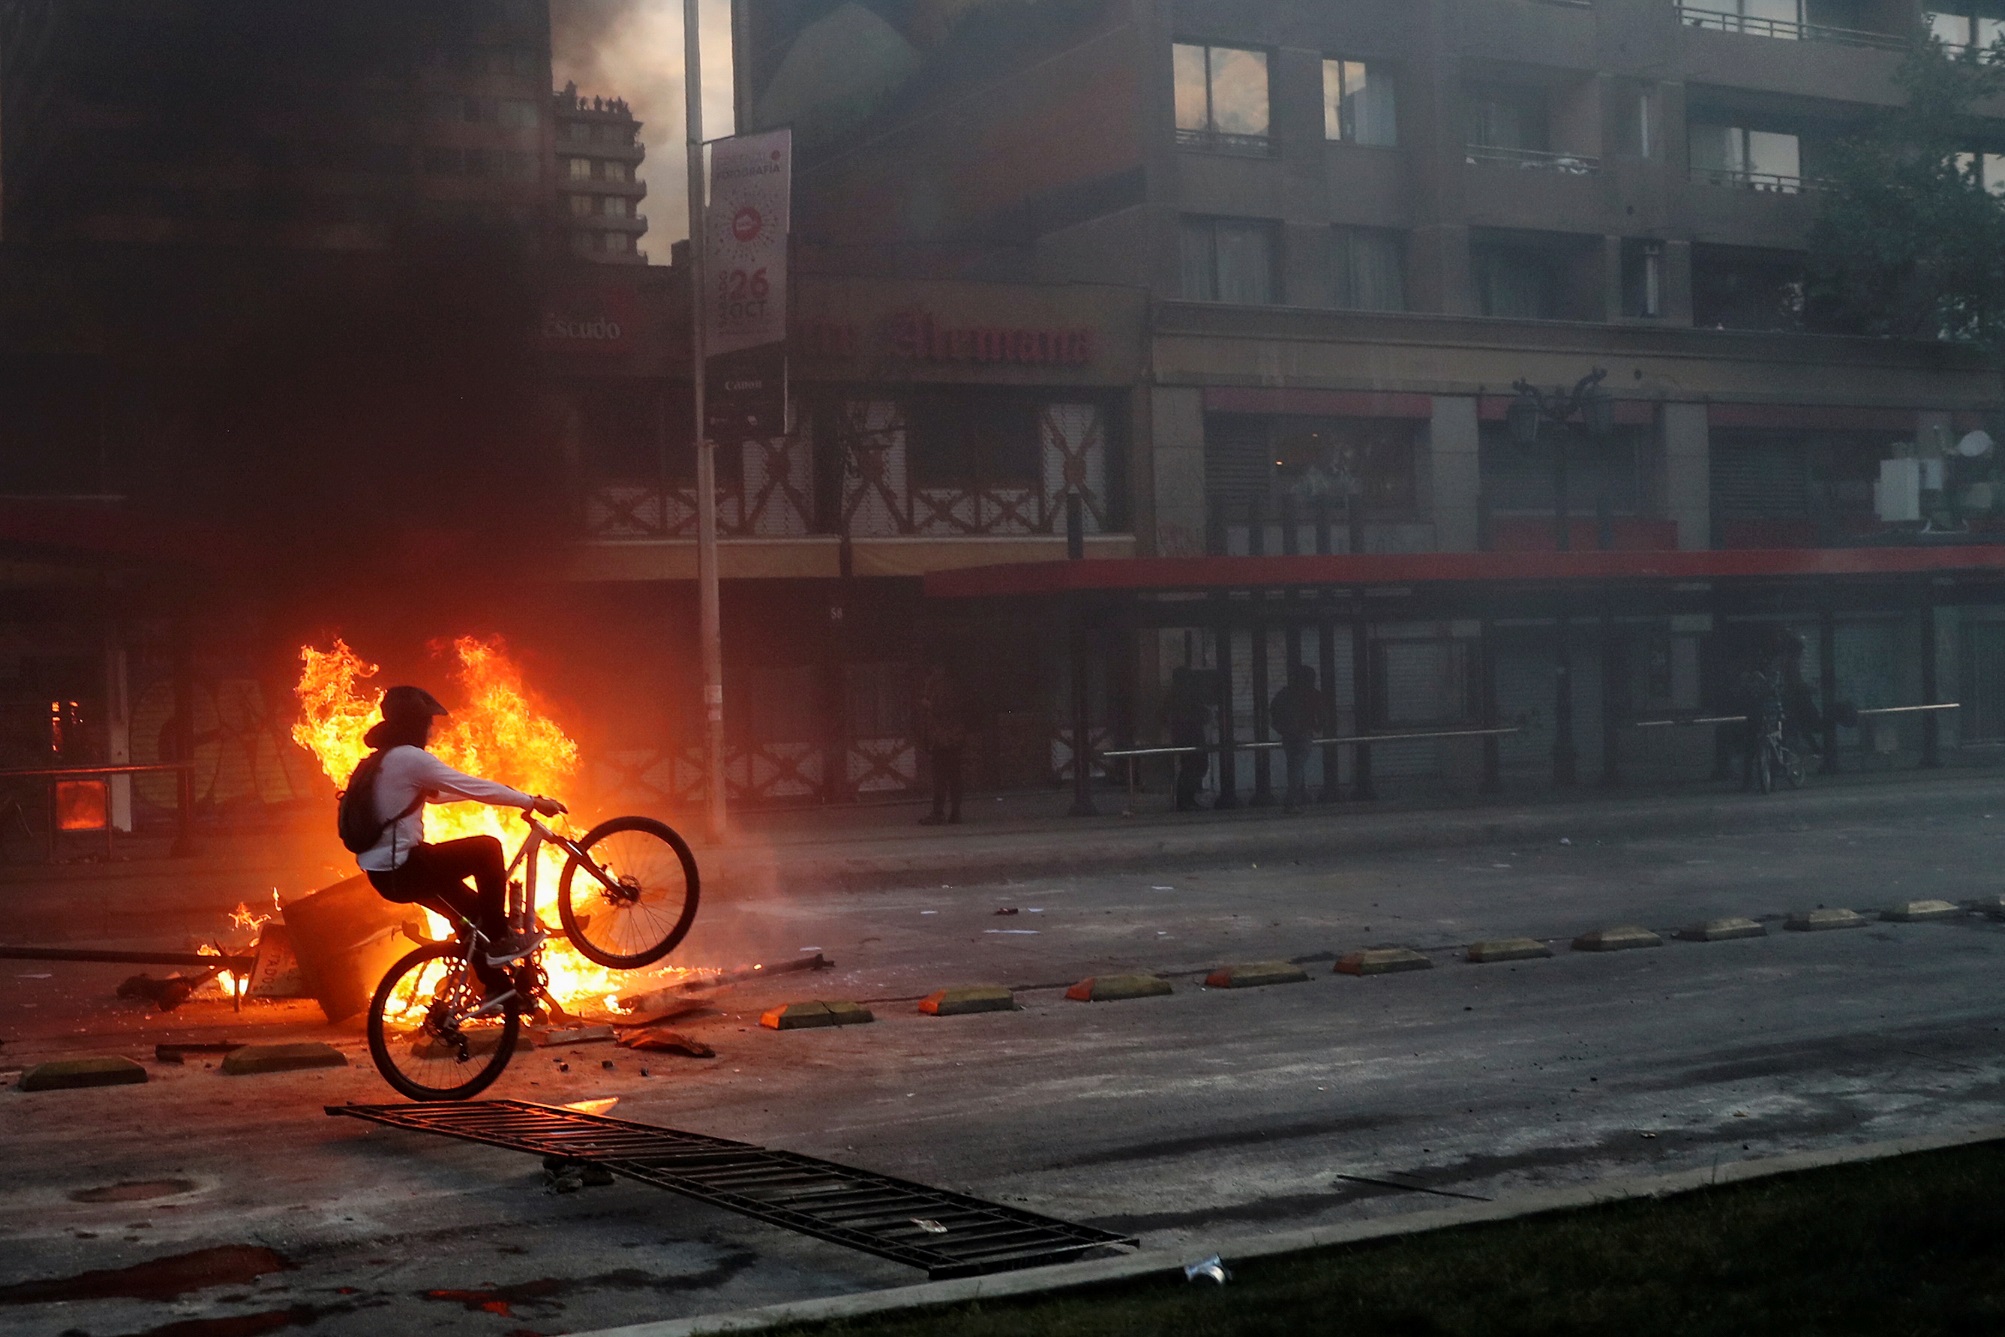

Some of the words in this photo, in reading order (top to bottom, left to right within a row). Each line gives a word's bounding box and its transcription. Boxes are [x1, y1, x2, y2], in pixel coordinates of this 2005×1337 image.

[730, 267, 769, 300] 26
[729, 299, 768, 320] OCT
[724, 380, 763, 391] Canon
